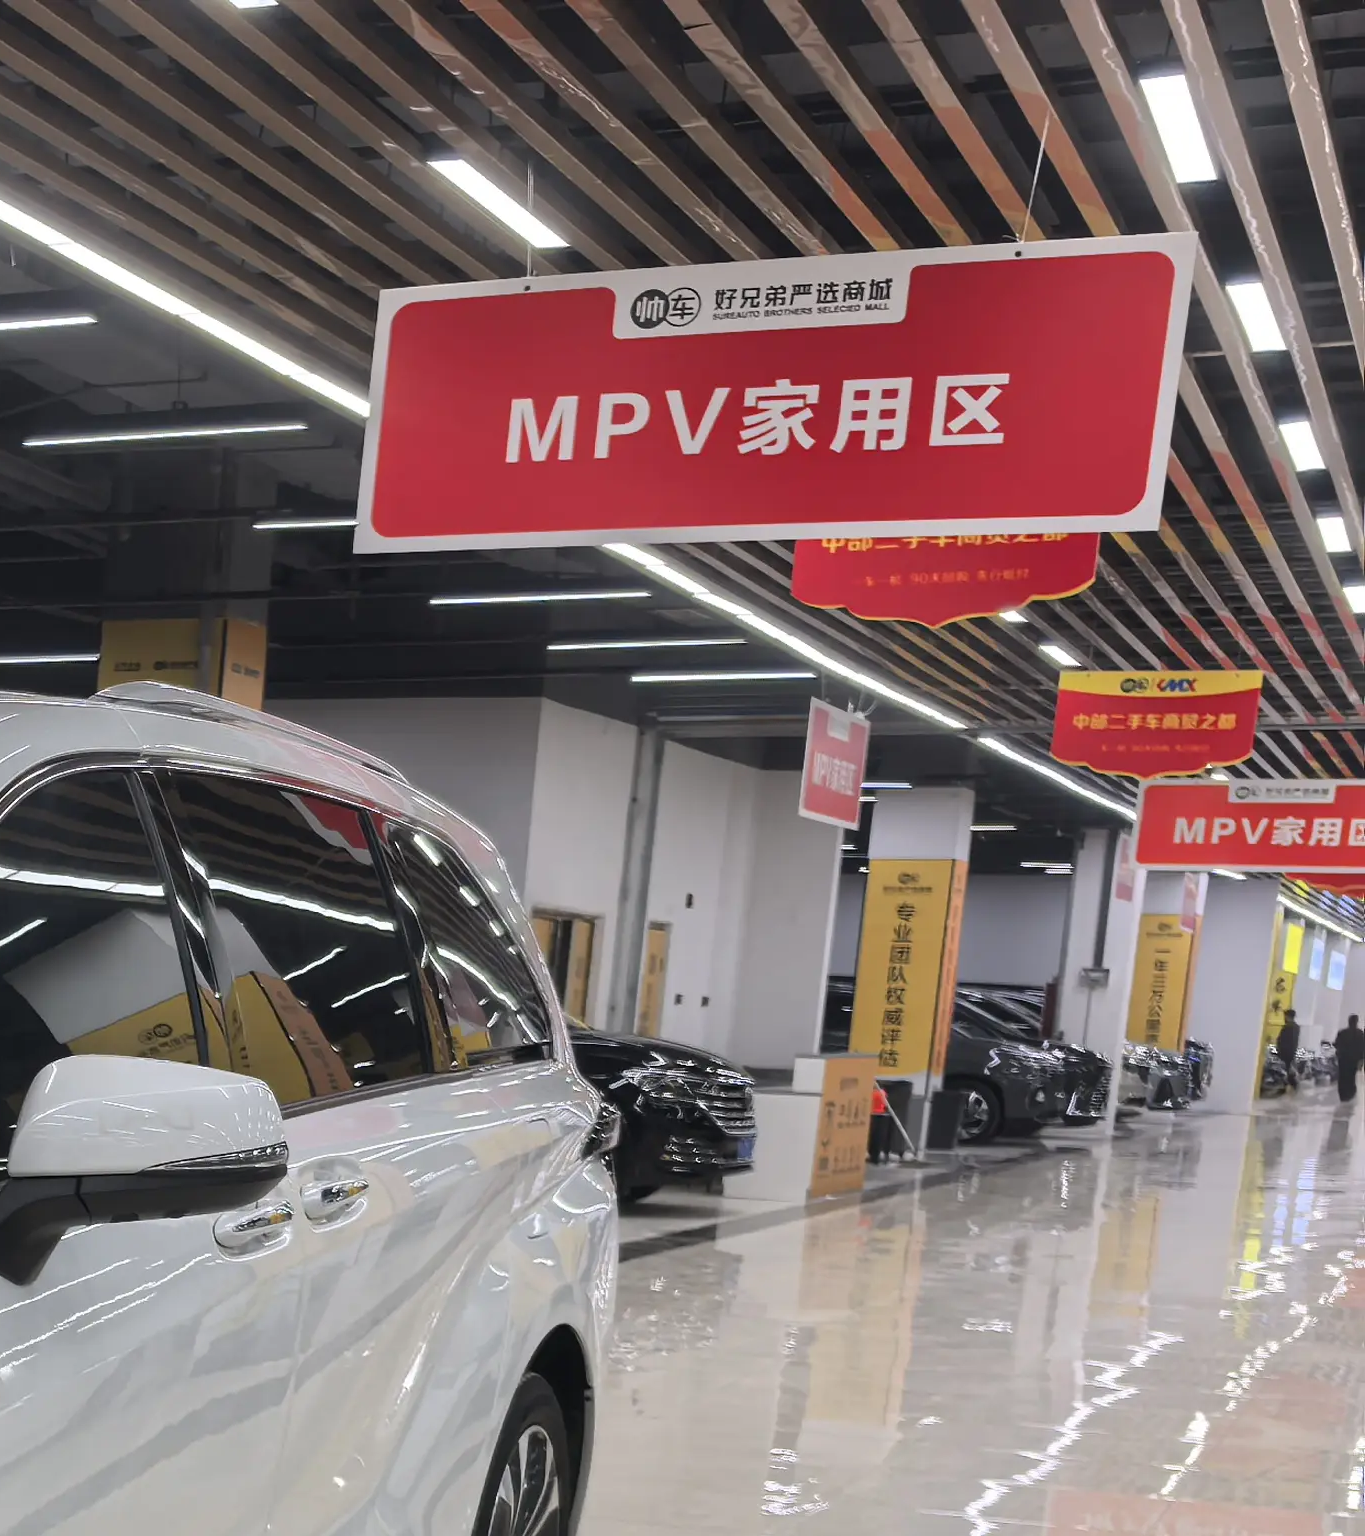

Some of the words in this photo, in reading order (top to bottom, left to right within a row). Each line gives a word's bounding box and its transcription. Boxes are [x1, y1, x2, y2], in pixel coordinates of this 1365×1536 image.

[714, 278, 894, 311] 好兄弟严选商城
[504, 373, 1011, 464] MPV家用区
